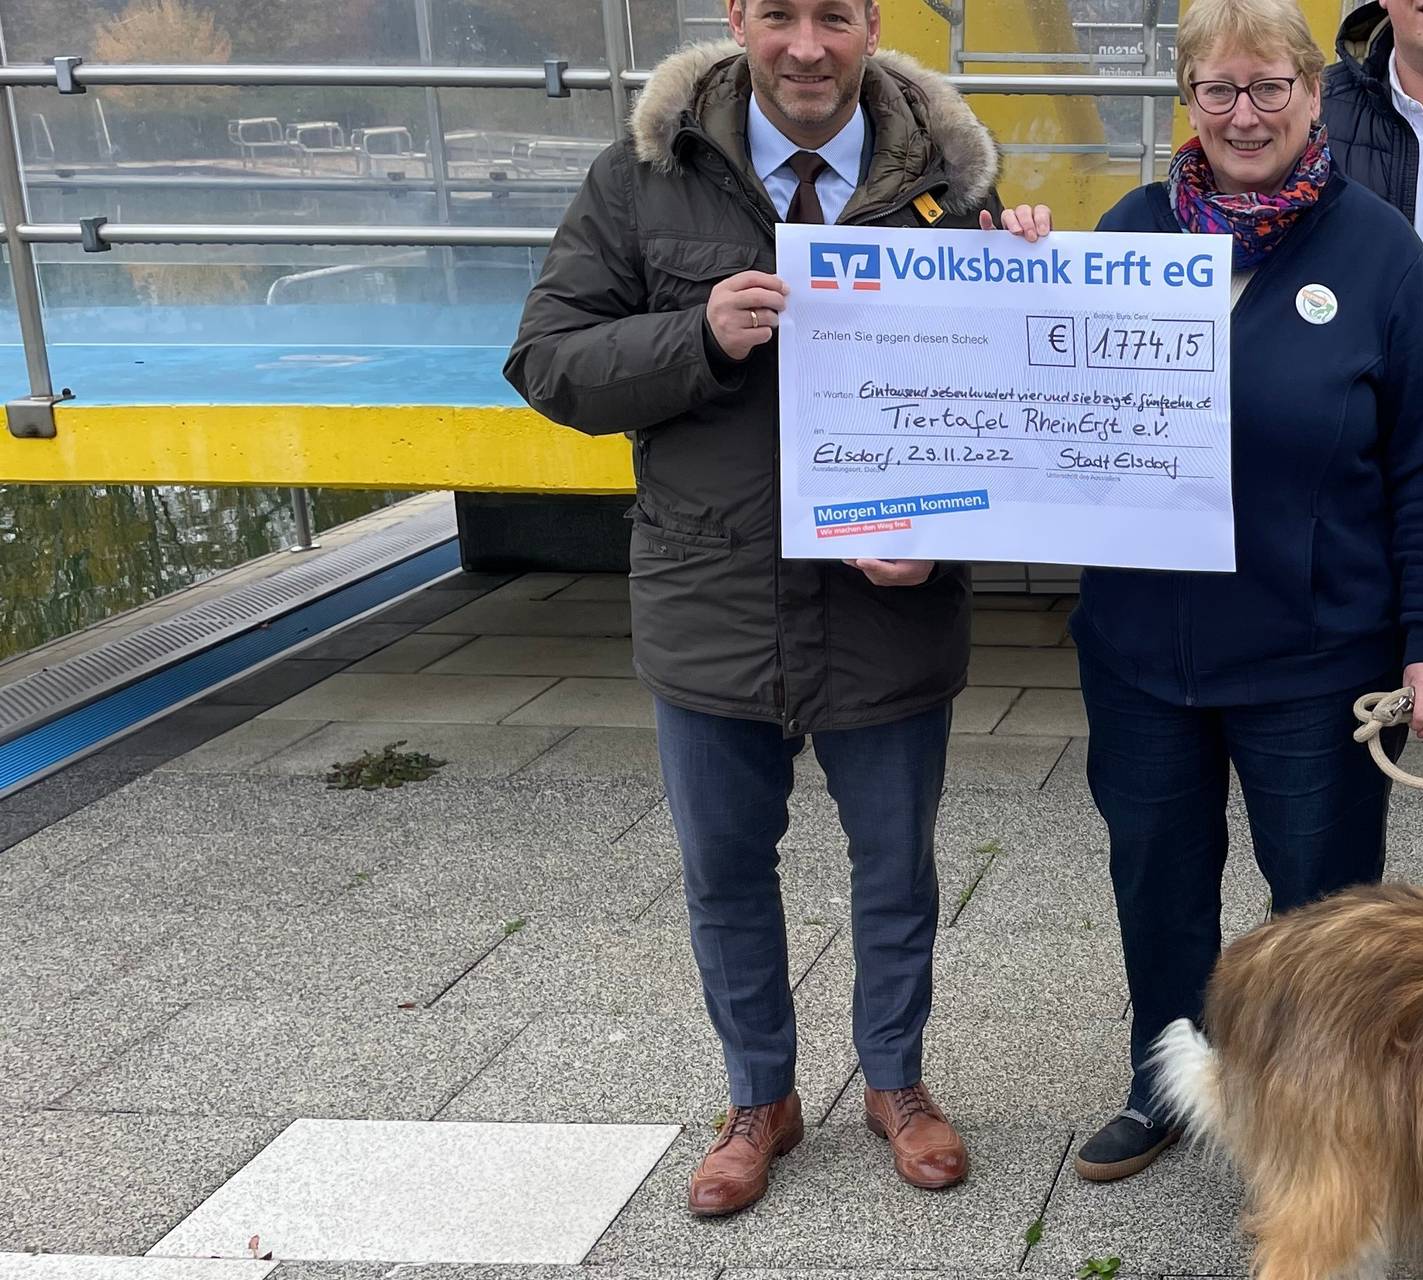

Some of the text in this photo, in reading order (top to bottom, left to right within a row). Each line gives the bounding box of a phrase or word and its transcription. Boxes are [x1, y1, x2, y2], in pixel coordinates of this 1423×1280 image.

[886, 246, 1214, 288] Volksbank Erft eG
[812, 330, 989, 345] Zahlen Sie gegen diesen Scheck
[1048, 324, 1068, 353] €
[1092, 327, 1204, 363] 1.774,15
[859, 380, 929, 399] Eintausend
[881, 403, 1009, 437] Tiertafel
[1132, 421, 1169, 438] e.V.
[813, 442, 1014, 471] Elsdorf, 29.11.2022
[1057, 448, 1178, 479] Stadt Elsdorf
[818, 495, 986, 522] Morgen kann kommen.
[820, 528, 833, 536] Wir
[834, 525, 861, 535] machen
[863, 523, 876, 532] den
[878, 522, 894, 531] Weg
